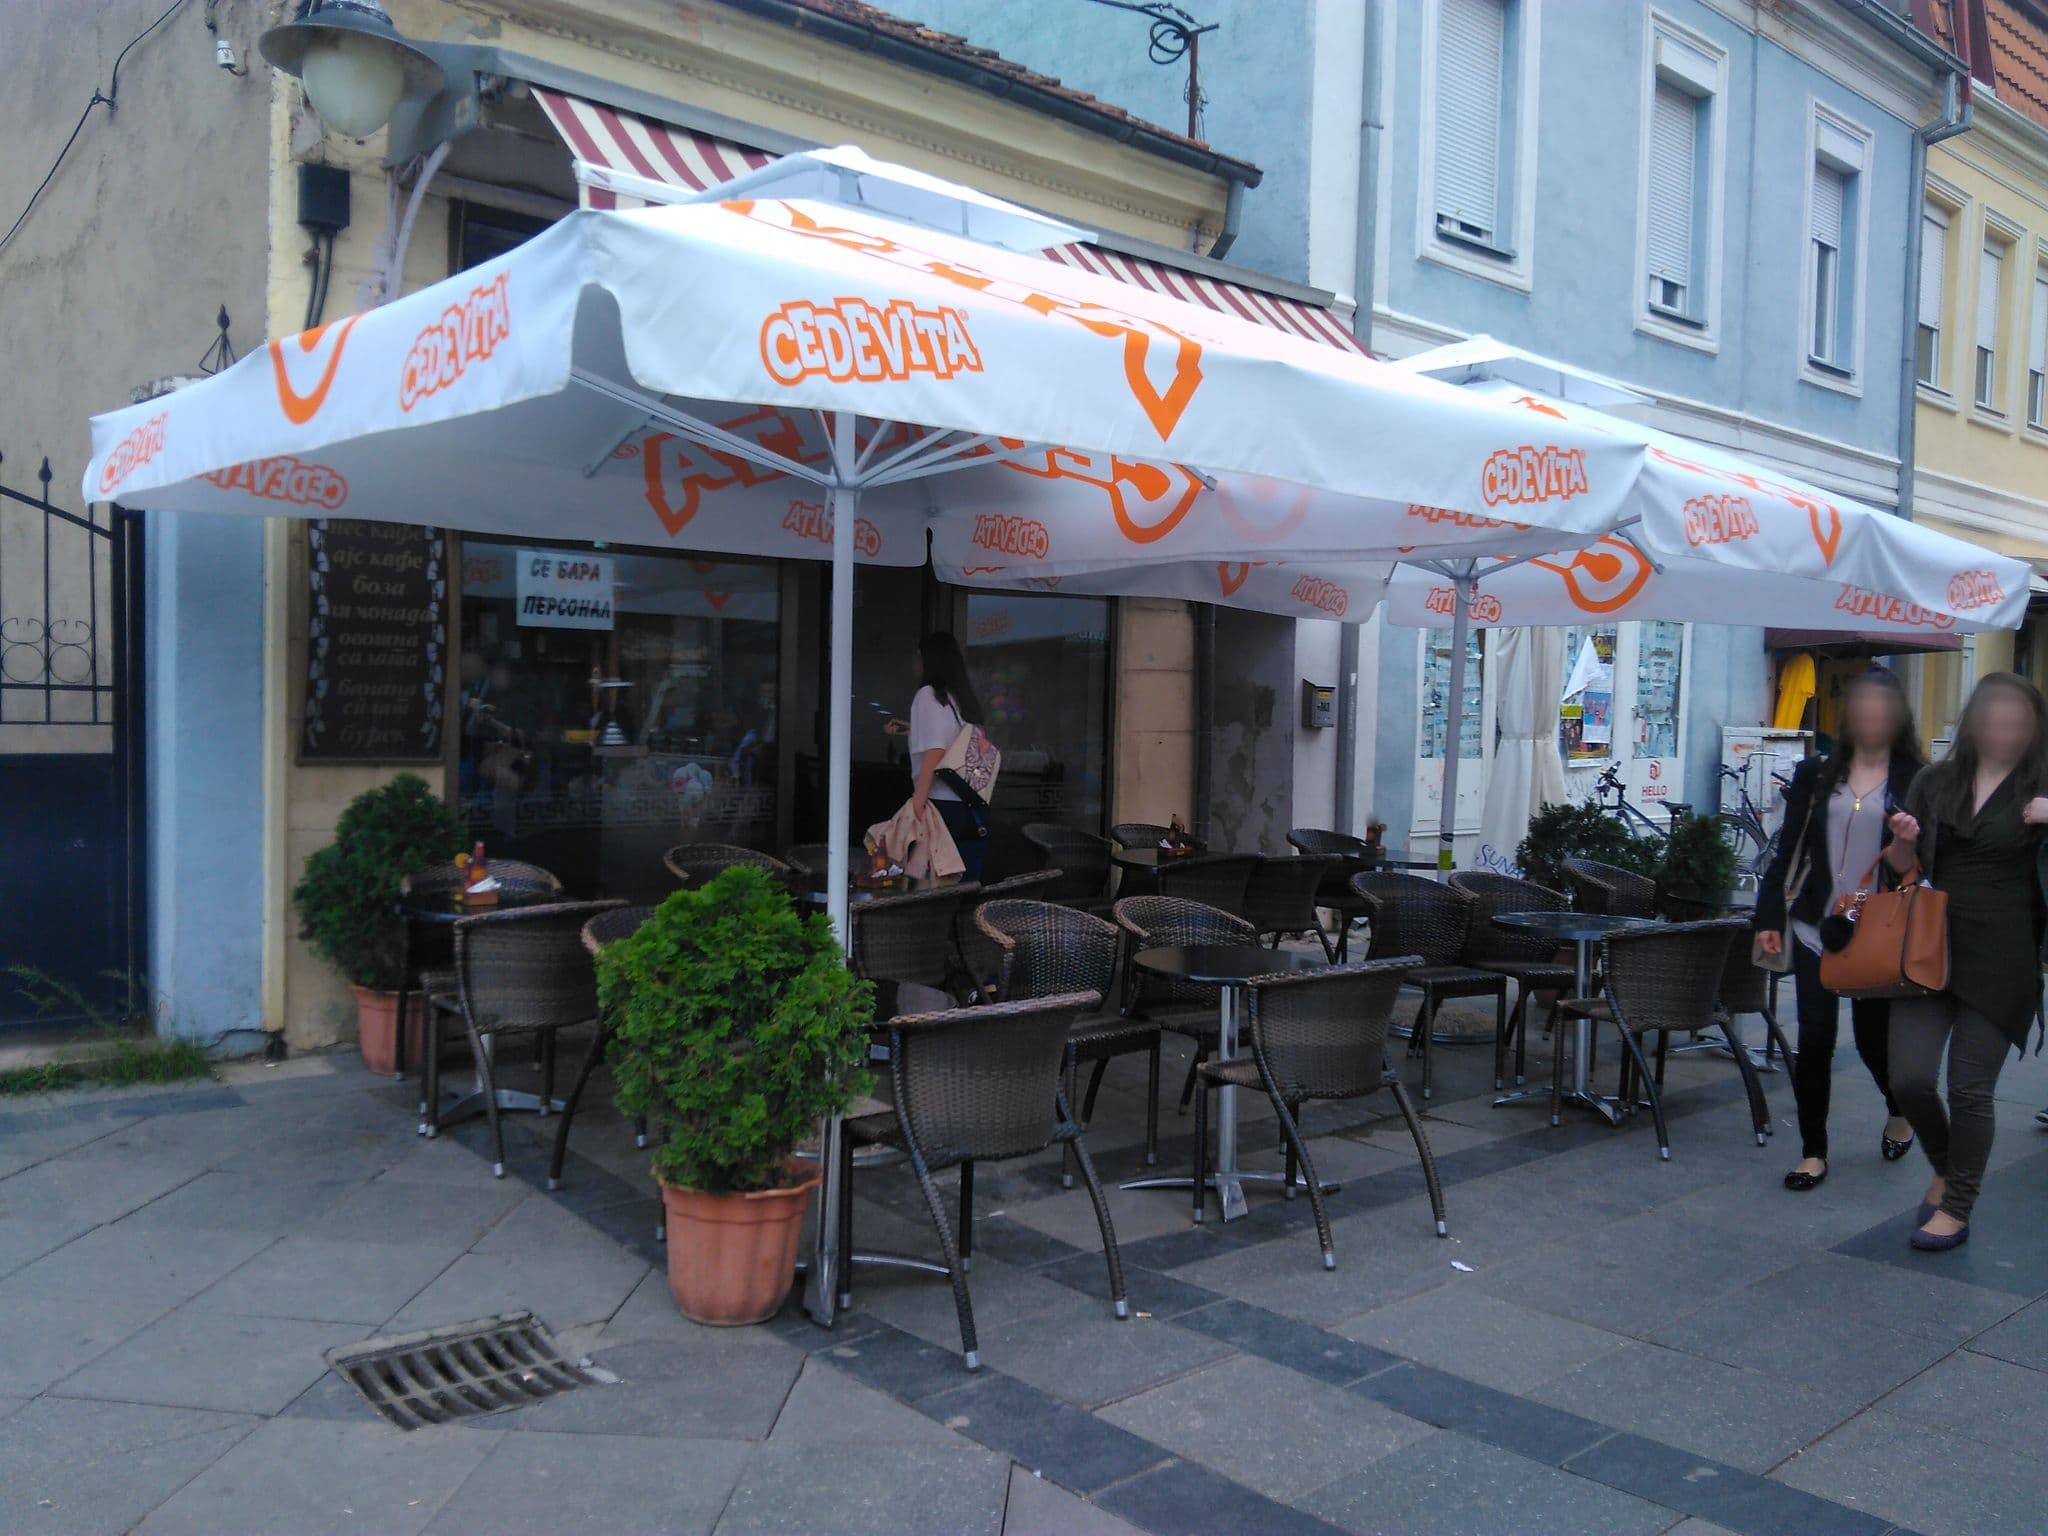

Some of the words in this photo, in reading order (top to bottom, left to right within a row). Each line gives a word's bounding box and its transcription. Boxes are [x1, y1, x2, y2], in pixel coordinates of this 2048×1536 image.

[400, 269, 511, 412] CEDEVITA
[759, 297, 984, 386] CEDEVITA
[1482, 445, 1588, 506] CEDEVITA
[1682, 494, 1760, 547] CEDEVITA
[530, 558, 552, 579] СЕ
[556, 559, 601, 582] БАРА
[523, 595, 610, 619] ПЕРСОНАЛ
[1641, 785, 1668, 796] HELLO
